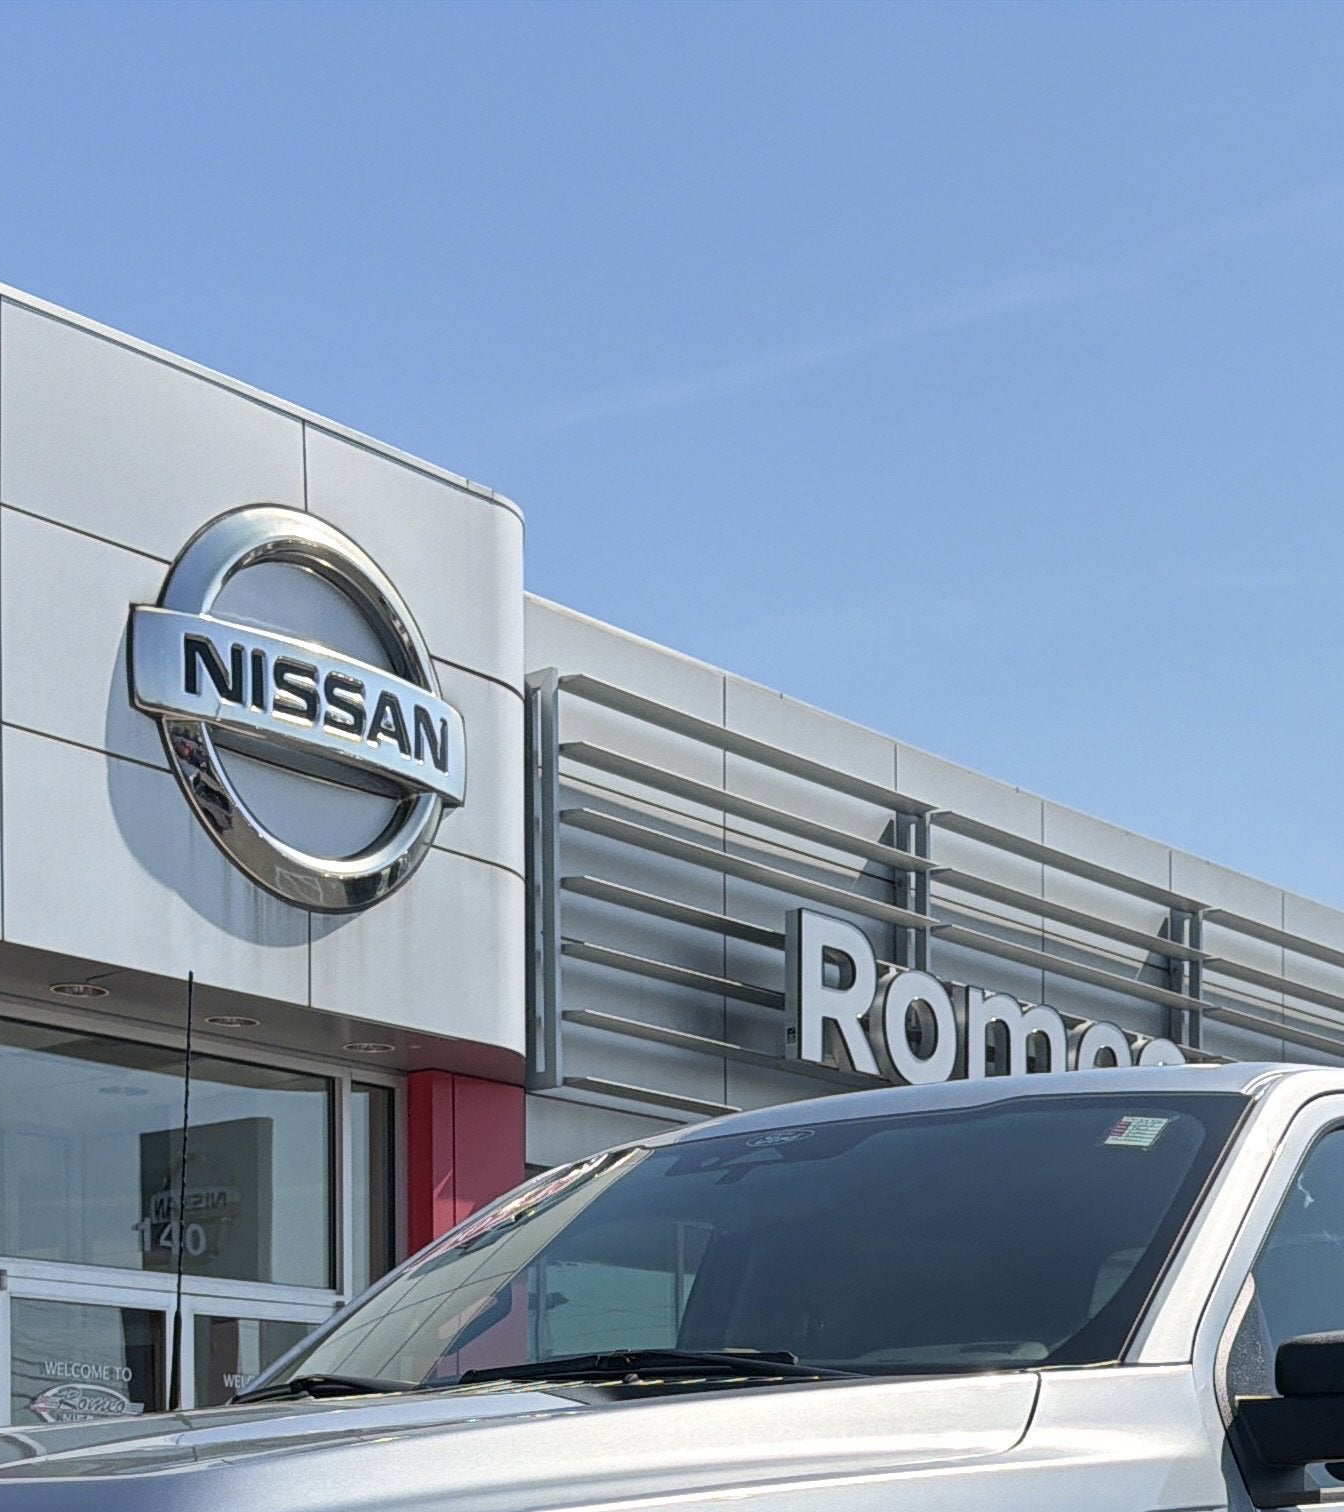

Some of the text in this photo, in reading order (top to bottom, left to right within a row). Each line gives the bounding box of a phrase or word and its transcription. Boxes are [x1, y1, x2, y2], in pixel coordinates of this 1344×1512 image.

[184, 632, 449, 775] NISSAN
[132, 1217, 207, 1256] 140
[44, 1361, 133, 1382] WELCOME TO
